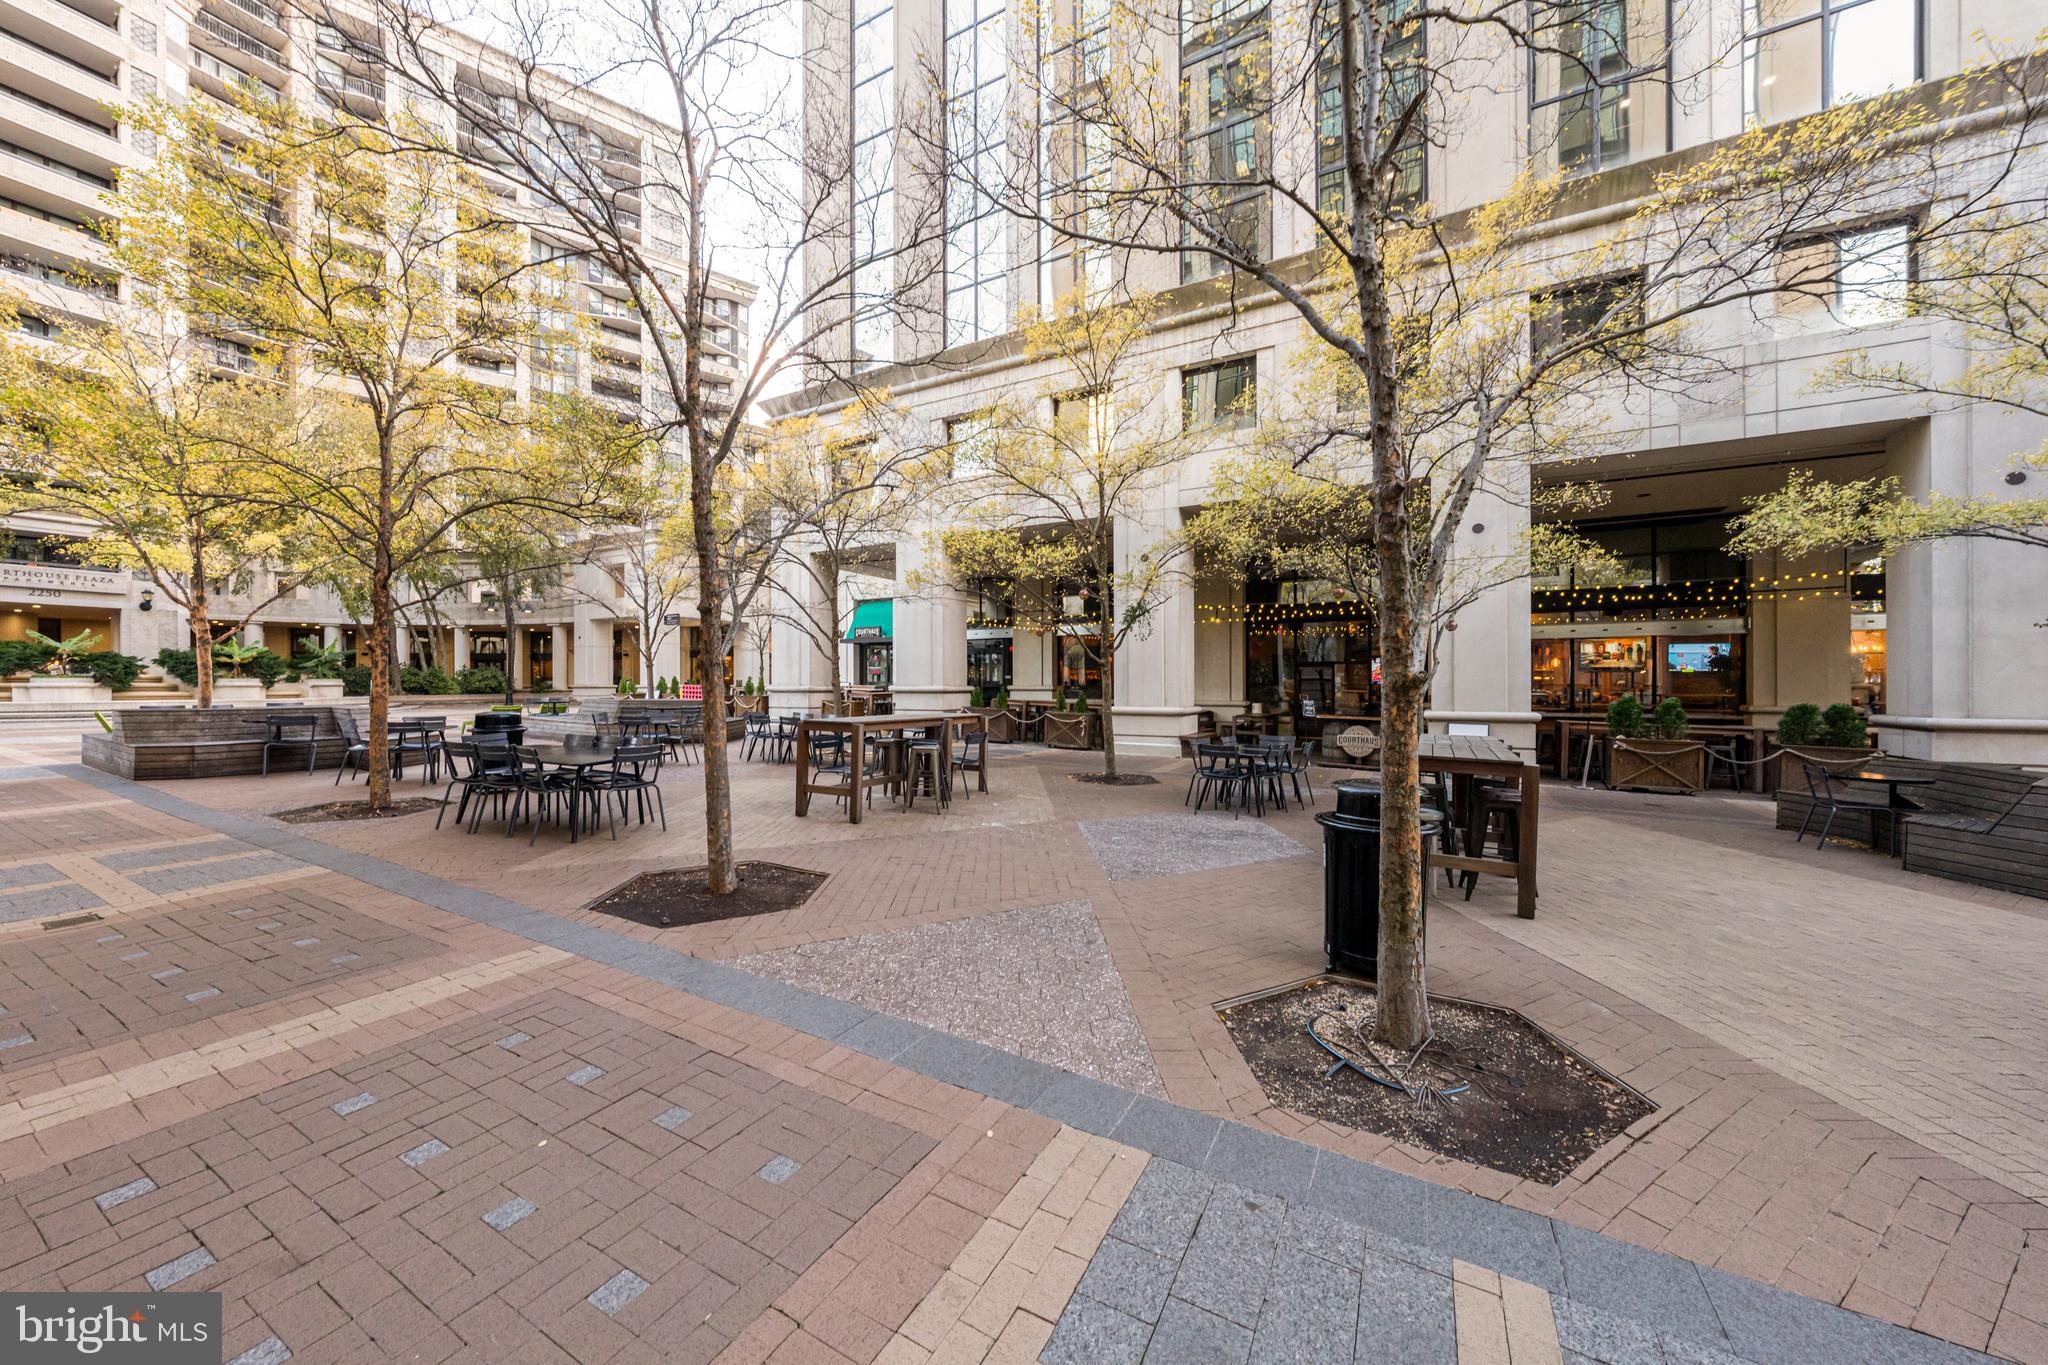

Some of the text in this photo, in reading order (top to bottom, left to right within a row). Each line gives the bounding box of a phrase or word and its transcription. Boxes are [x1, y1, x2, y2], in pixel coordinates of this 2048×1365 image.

[75, 575, 114, 584] PLAZA
[28, 588, 61, 598] 2250
[1338, 735, 1379, 747] COURTHAUS
